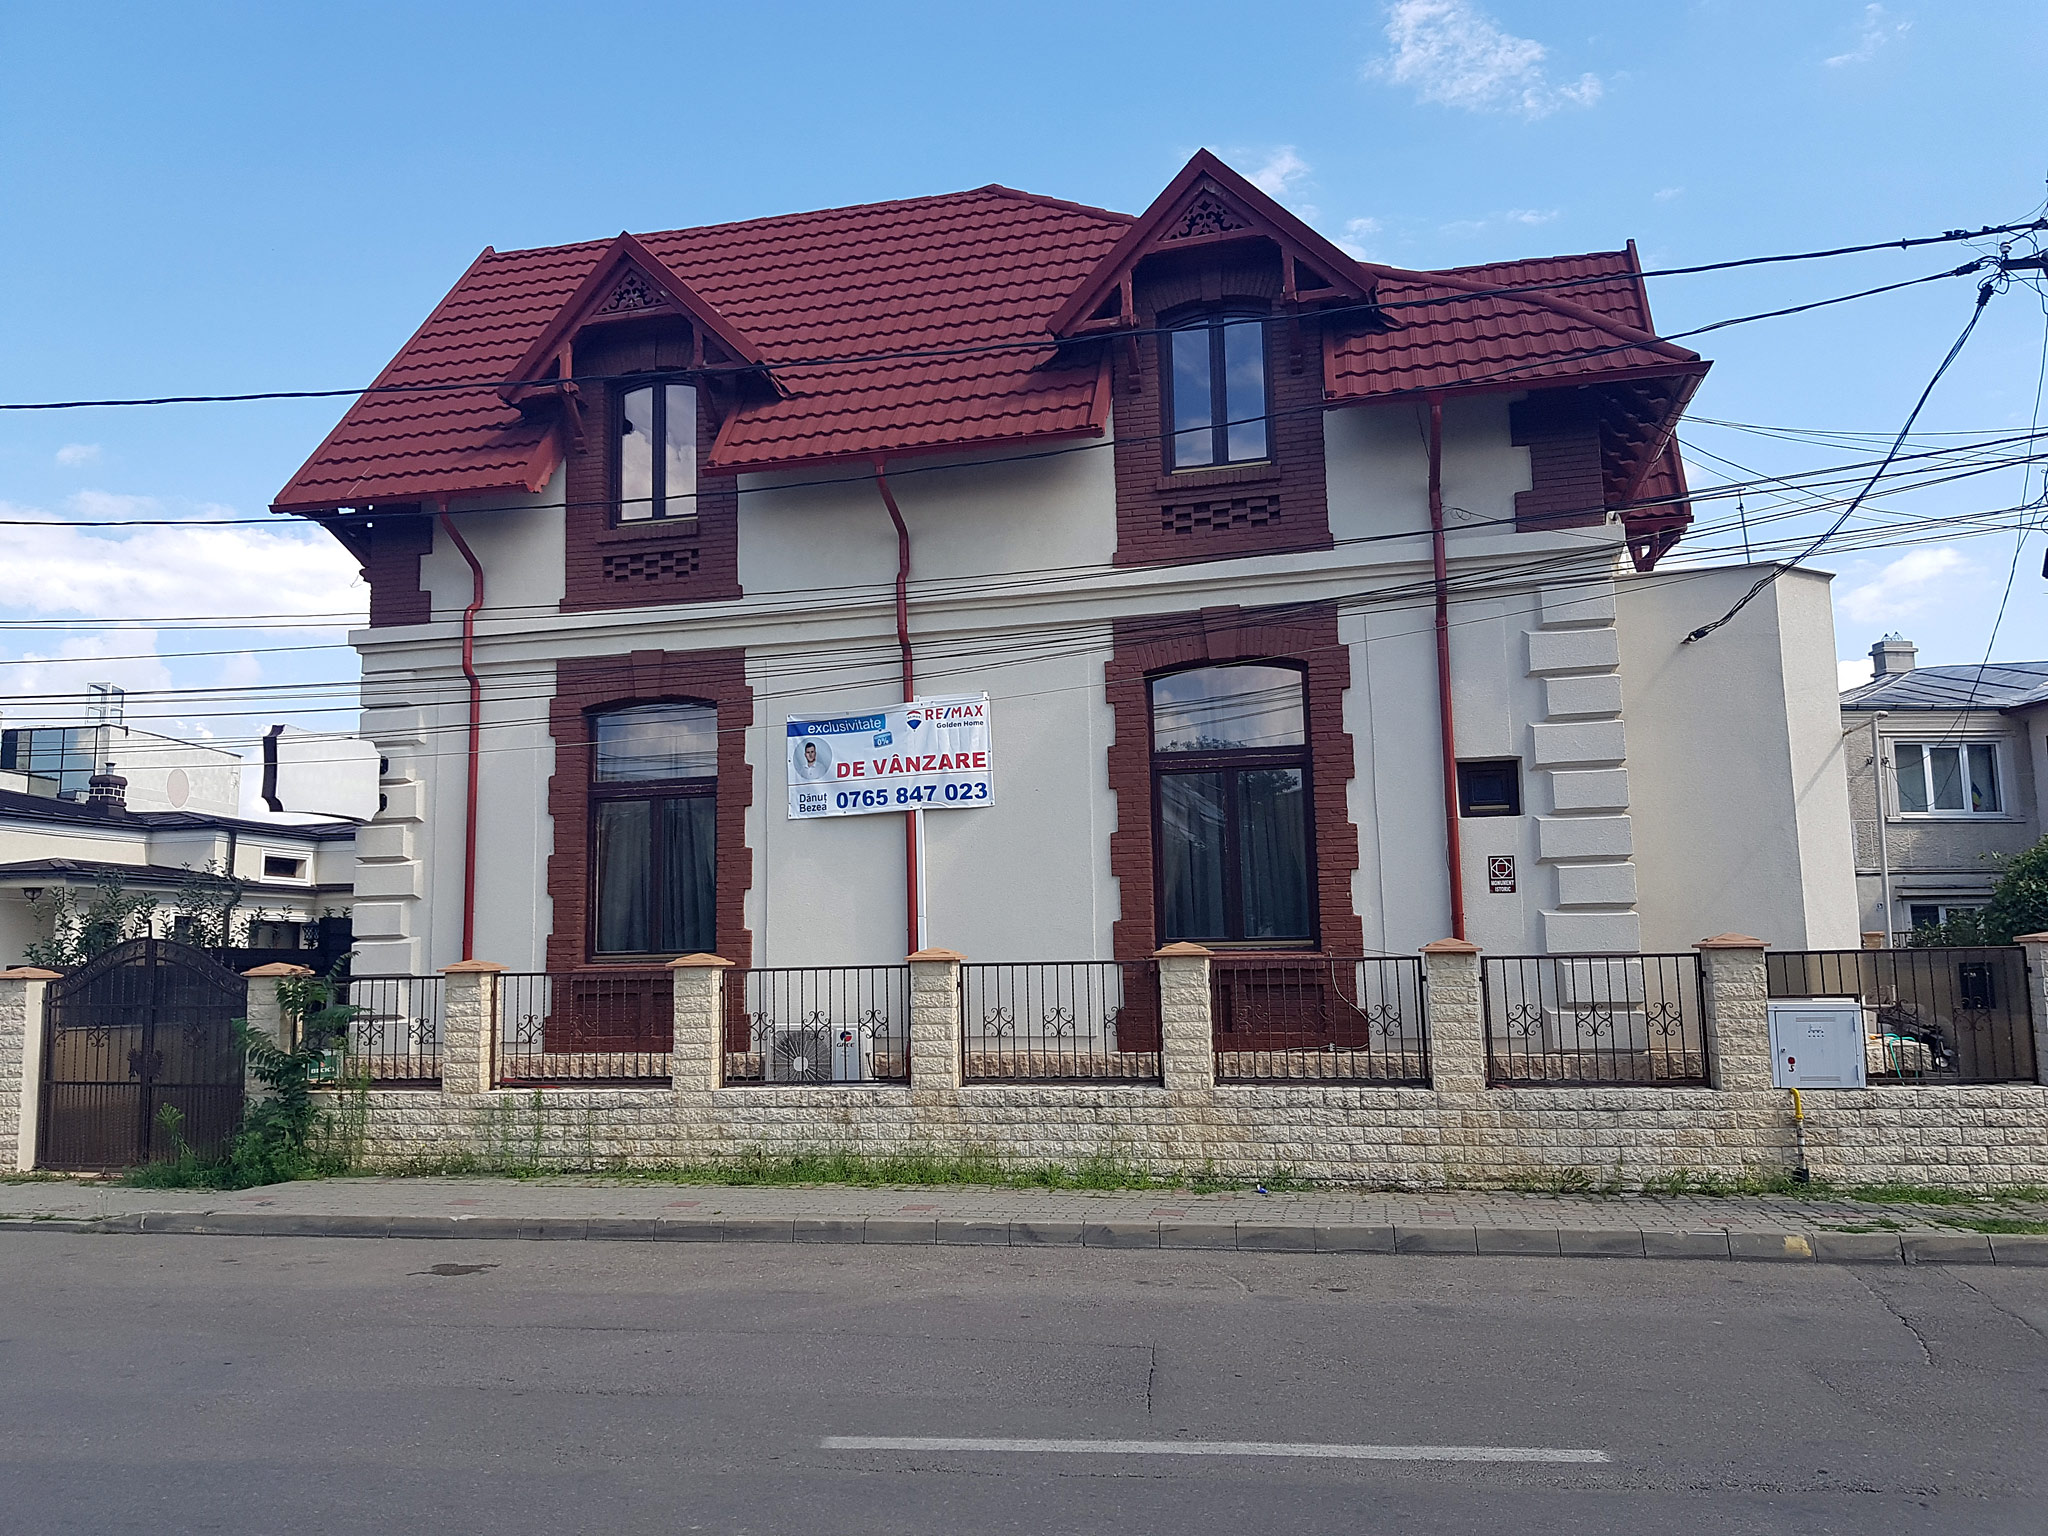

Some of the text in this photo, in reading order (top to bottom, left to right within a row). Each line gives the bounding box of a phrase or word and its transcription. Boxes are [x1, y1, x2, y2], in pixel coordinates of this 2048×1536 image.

[925, 704, 984, 721] RE/MAX
[808, 718, 881, 734] exclusivitate
[936, 721, 962, 729] Golden
[877, 737, 889, 746] 0%
[836, 751, 987, 779] DE VÂNZARE
[799, 792, 828, 803] Dănuț
[836, 782, 988, 809] 0765 847 023
[799, 803, 827, 813] Bezea
